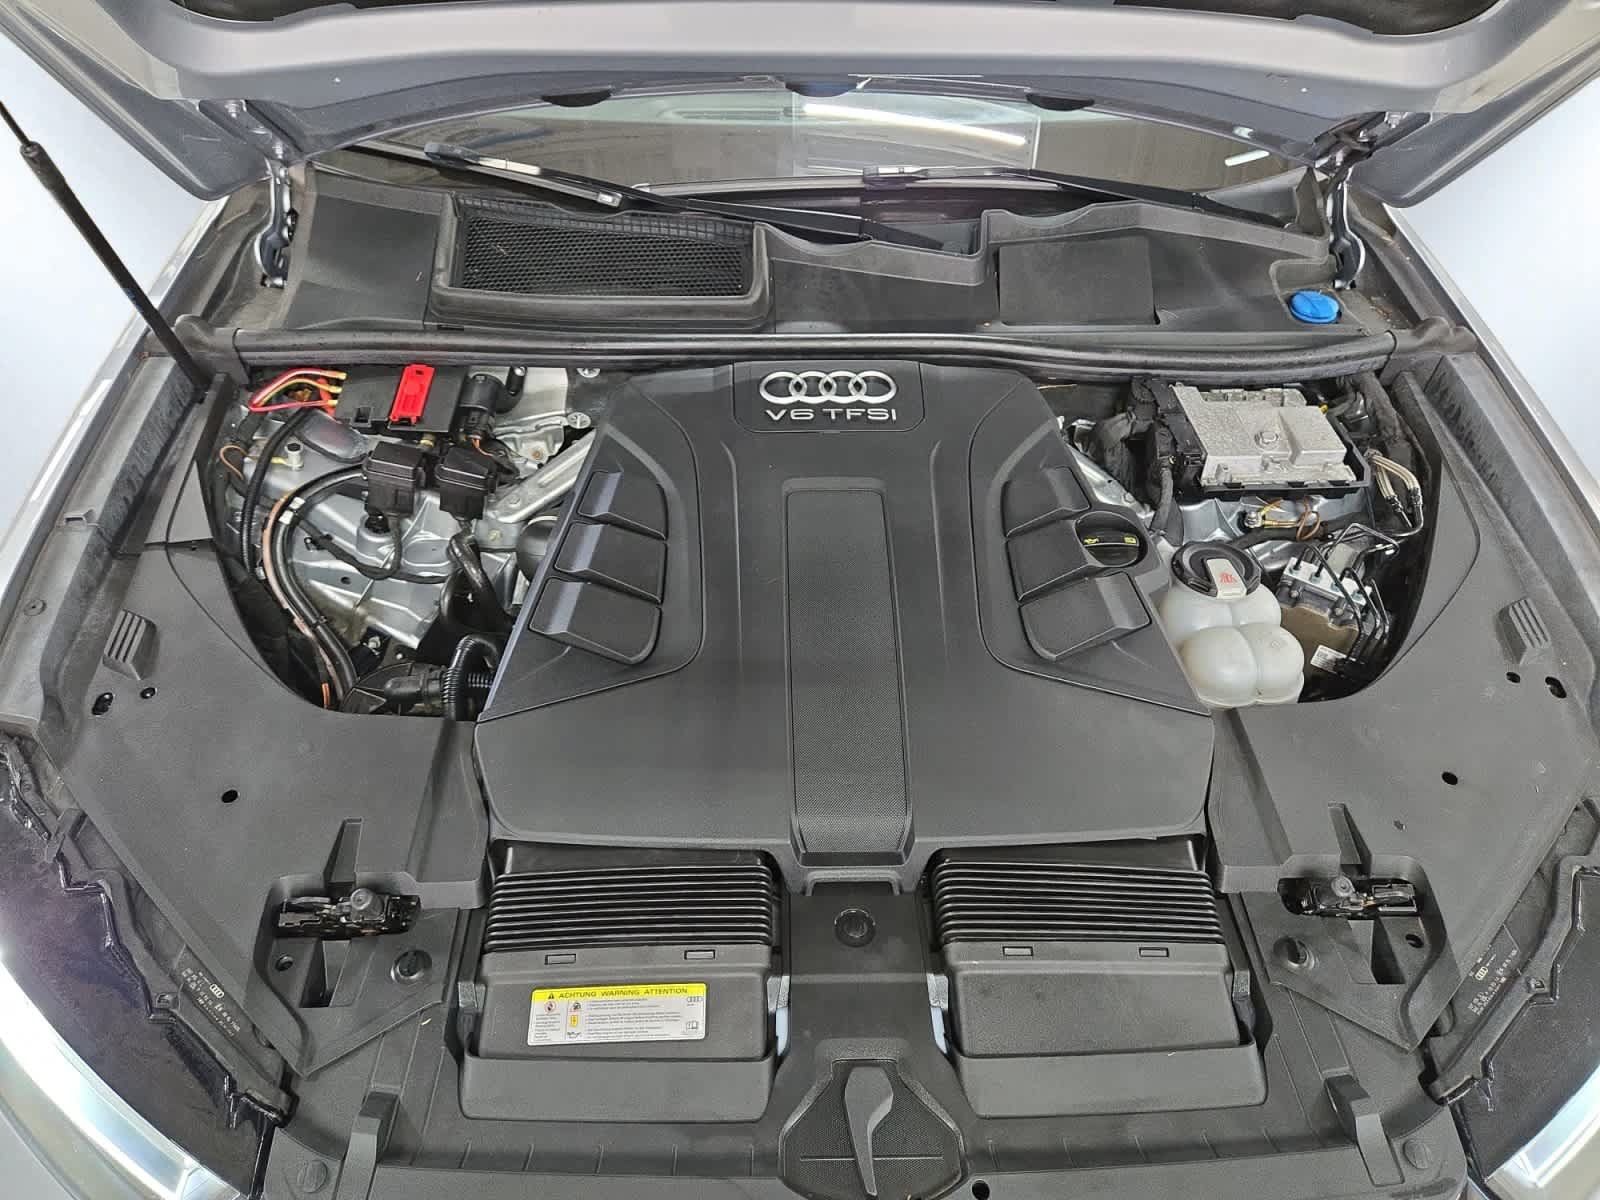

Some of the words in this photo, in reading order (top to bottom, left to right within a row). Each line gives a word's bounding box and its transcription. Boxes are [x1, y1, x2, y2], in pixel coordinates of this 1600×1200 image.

[765, 408, 814, 421] V6
[822, 408, 897, 421] TFSI
[559, 991, 597, 999] ACHTUNG
[601, 989, 640, 997] WARNING
[644, 987, 688, 996] ATTENTION
